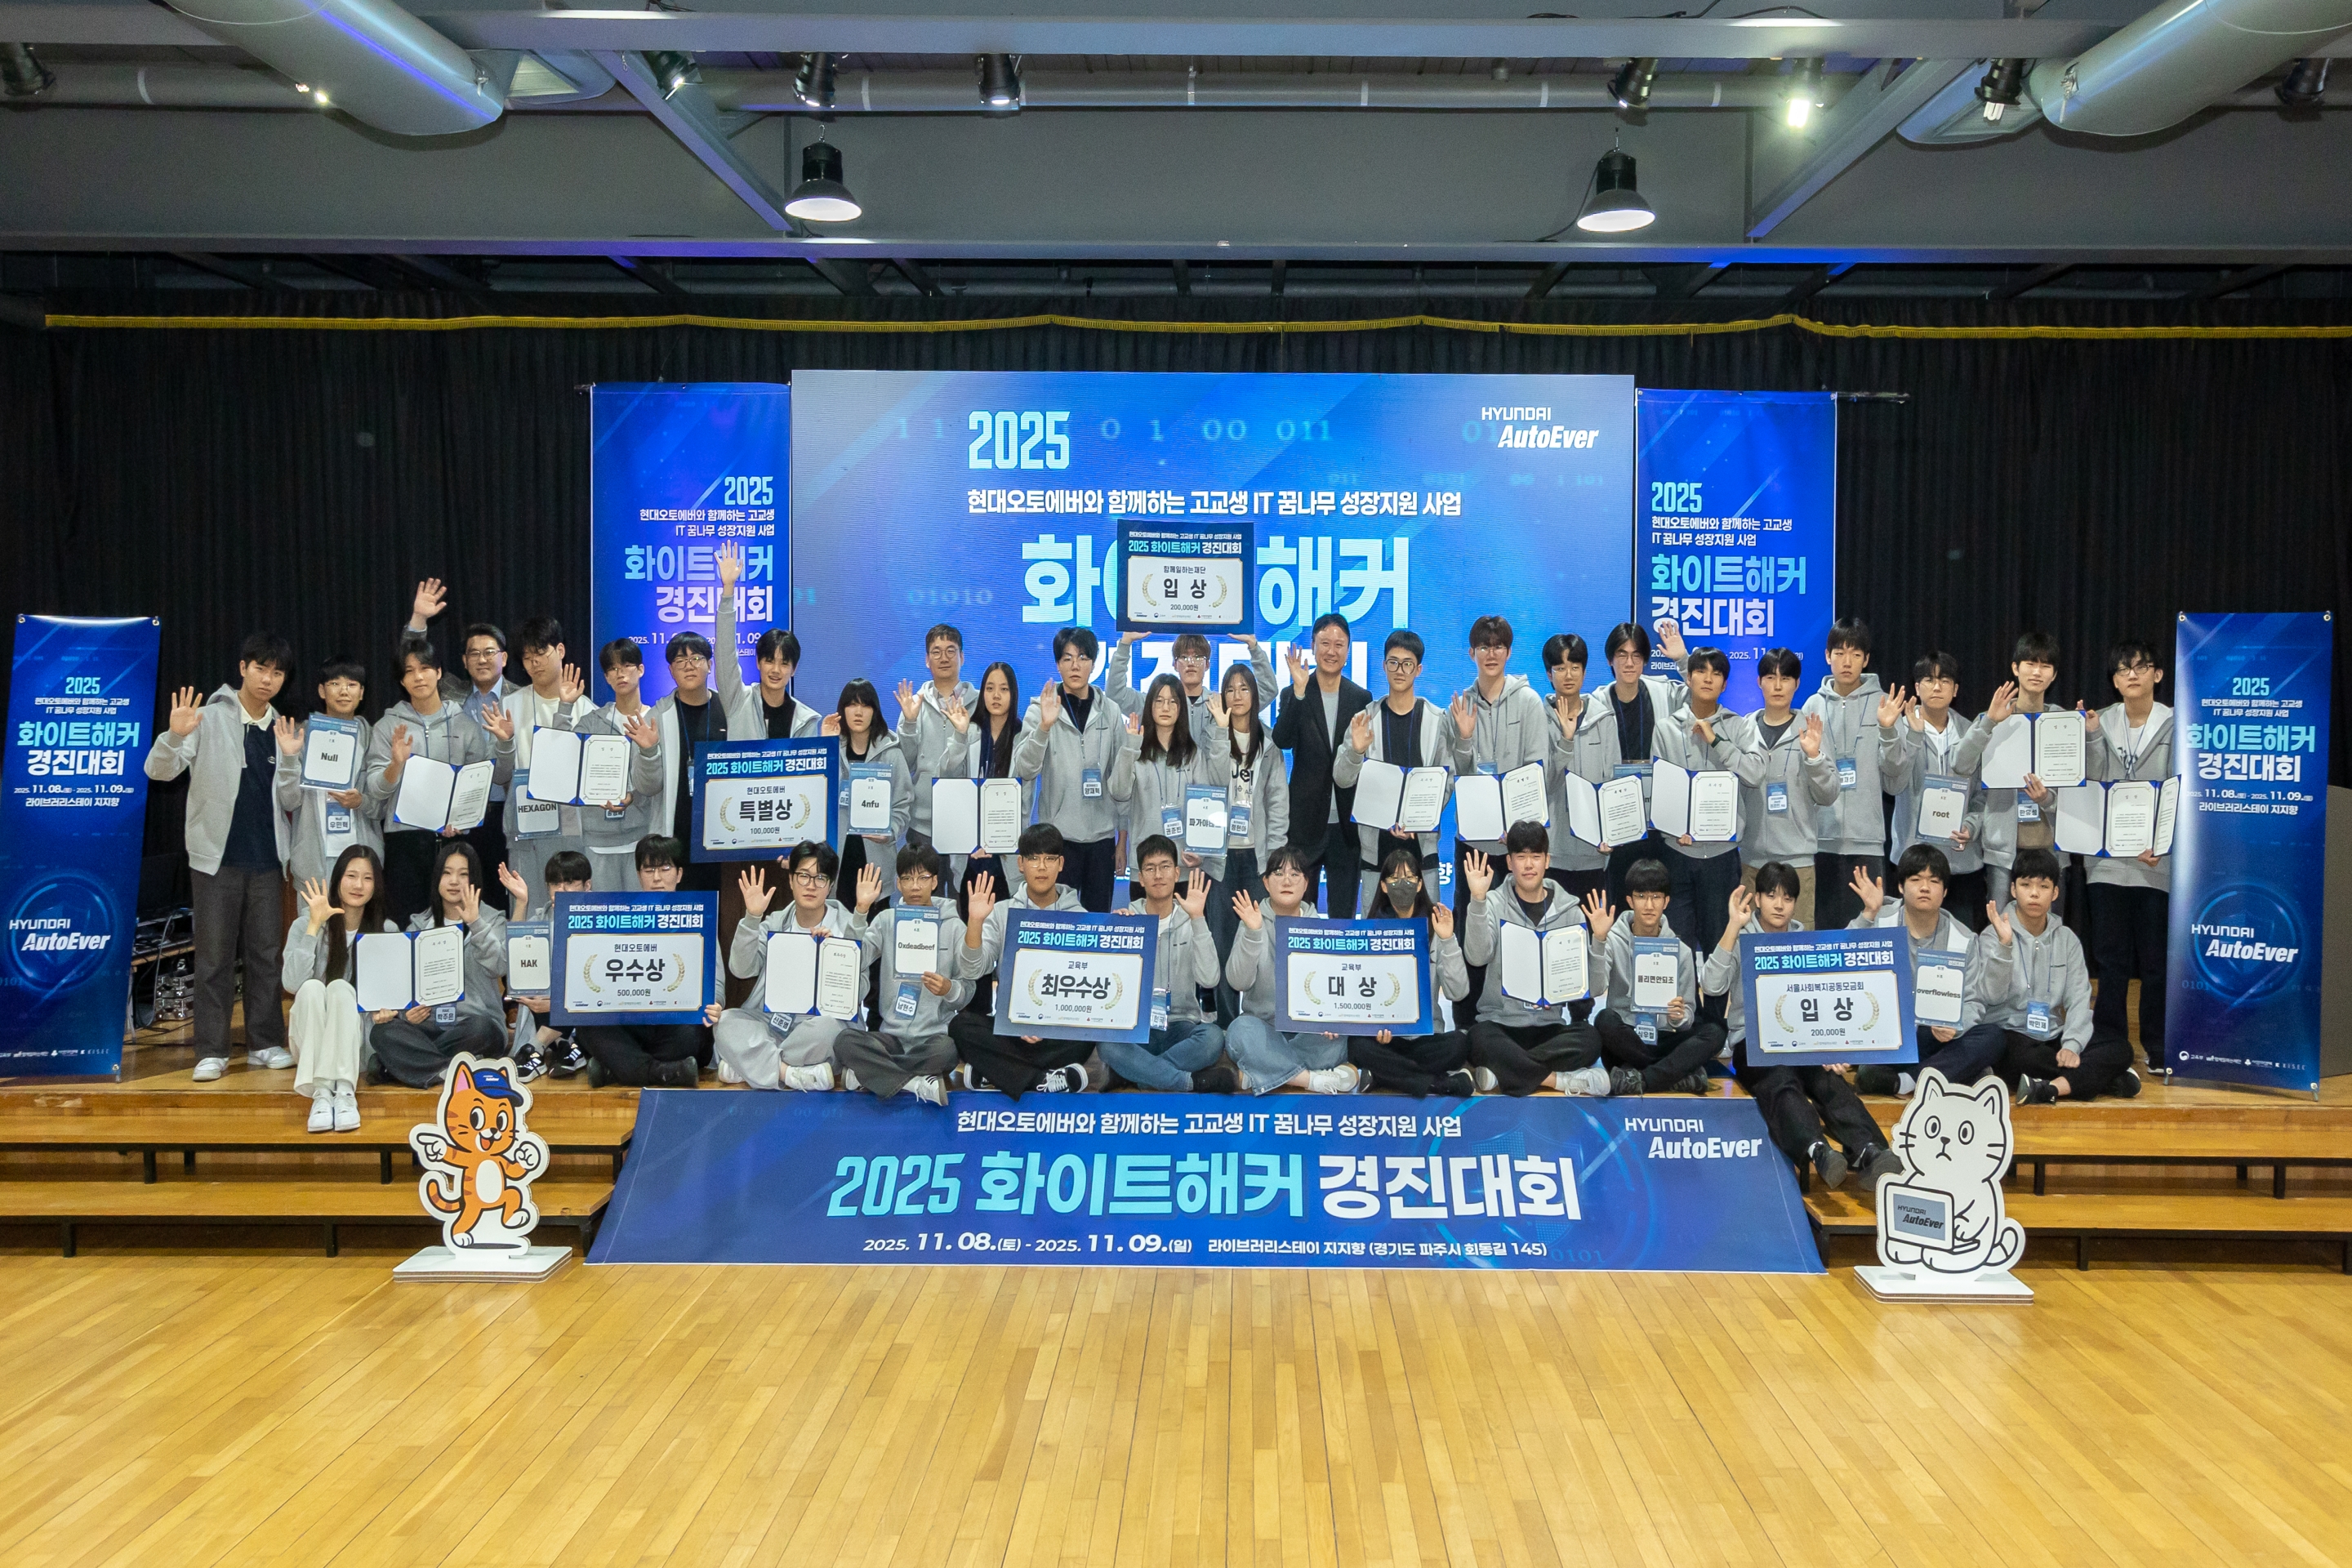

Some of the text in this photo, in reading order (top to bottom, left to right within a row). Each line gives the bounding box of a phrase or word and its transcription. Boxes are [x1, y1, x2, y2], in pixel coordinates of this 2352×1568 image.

[1481, 408, 1551, 421] HYUNDAI
[969, 411, 1070, 470] 2025
[1498, 425, 1599, 448] AutoEver
[724, 476, 773, 506] 2025
[1651, 482, 1703, 512] 2025
[968, 489, 1461, 516] 현대오토에버와 함께하는 고교생 IT 꿈나무 성장지원 사업
[639, 509, 774, 521] 현대오토에버와 함께하는 고교생
[675, 523, 774, 537] IT 꿈나무 성장지원 사업
[1651, 516, 1793, 532] 현대오토에버와 함께하는 고교생
[1652, 532, 1757, 546] IT 꿈나무 성장지원 사업
[1129, 540, 1242, 555] 2025 화이트해커 경진대회
[1022, 534, 1409, 628] 화해커
[1651, 553, 1806, 595] 화이트해커
[1652, 597, 1774, 637] 경진대회
[1730, 652, 1750, 660] 2025.
[65, 677, 100, 694] 2025
[2233, 678, 2270, 696] 2025
[17, 721, 140, 747] 화이트해커
[2186, 724, 2315, 752] 화이트해커
[28, 750, 124, 776] 경진대회
[321, 752, 338, 762] Null
[706, 757, 826, 774] 2025 화이트해커 경진대회
[2198, 753, 2301, 782] 경진대회
[747, 786, 785, 795] 현대오토에버
[26, 798, 119, 807] 라이브러리스테이 지지향
[518, 804, 557, 813] HEXAGON
[2199, 802, 2298, 814] 라이브러리스테이 지지향
[739, 799, 792, 822] 특별상
[1933, 810, 1949, 818] root
[751, 826, 780, 835] 100,000원
[1189, 818, 1221, 828] 파가야
[9, 919, 70, 930] HYUNDAI
[568, 914, 703, 929] 2025 화이트해커 경진대회
[2191, 924, 2254, 938] HYUNDAI
[21, 933, 110, 951] AutoEver
[898, 942, 935, 951] 0xdeadbeef
[1018, 931, 1143, 949] 2025 화이트해커 경진대회
[1288, 937, 1414, 951] 2025 화이트해커 경진대회
[614, 944, 657, 952] 현대오토에버
[2206, 939, 2298, 963] AutoEver
[521, 960, 537, 968] HAK
[1068, 960, 1088, 969] 교육부
[1341, 963, 1361, 971] 교육부
[1755, 951, 1894, 970] 2025 화이트해커 경진대회
[605, 958, 665, 982] 우수상
[1041, 973, 1111, 999] 최우수상
[1787, 982, 1864, 993] 서울사회복지공동모금회
[1917, 989, 1961, 998] overflowless
[1055, 1004, 1092, 1013] 1,000,000원
[1334, 1002, 1371, 1010] 1,500,000원
[1811, 1028, 1846, 1036] 200,000원
[957, 1111, 1462, 1138] 현대오토에버와 함께하는 고교생 IT 꿈나무 성장지원 사업
[1625, 1118, 1704, 1132] HYUNDAI
[1648, 1137, 1762, 1159] AutoEver
[826, 1151, 1582, 1220] 2025 화이트해커 경진대회
[1897, 1205, 1927, 1214] HYUNDAI
[1903, 1214, 1944, 1230] AutoEver
[864, 1239, 910, 1251] 2025.
[1035, 1240, 1081, 1252] 2025.
[1208, 1239, 1320, 1255] 라이브러리스테이
[1324, 1241, 1365, 1256] 지지향
[1369, 1241, 1416, 1257] (경기도
[1419, 1242, 1461, 1257] 파주시
[1464, 1242, 1507, 1256] 회동길
[1511, 1242, 1548, 1257] 145)
